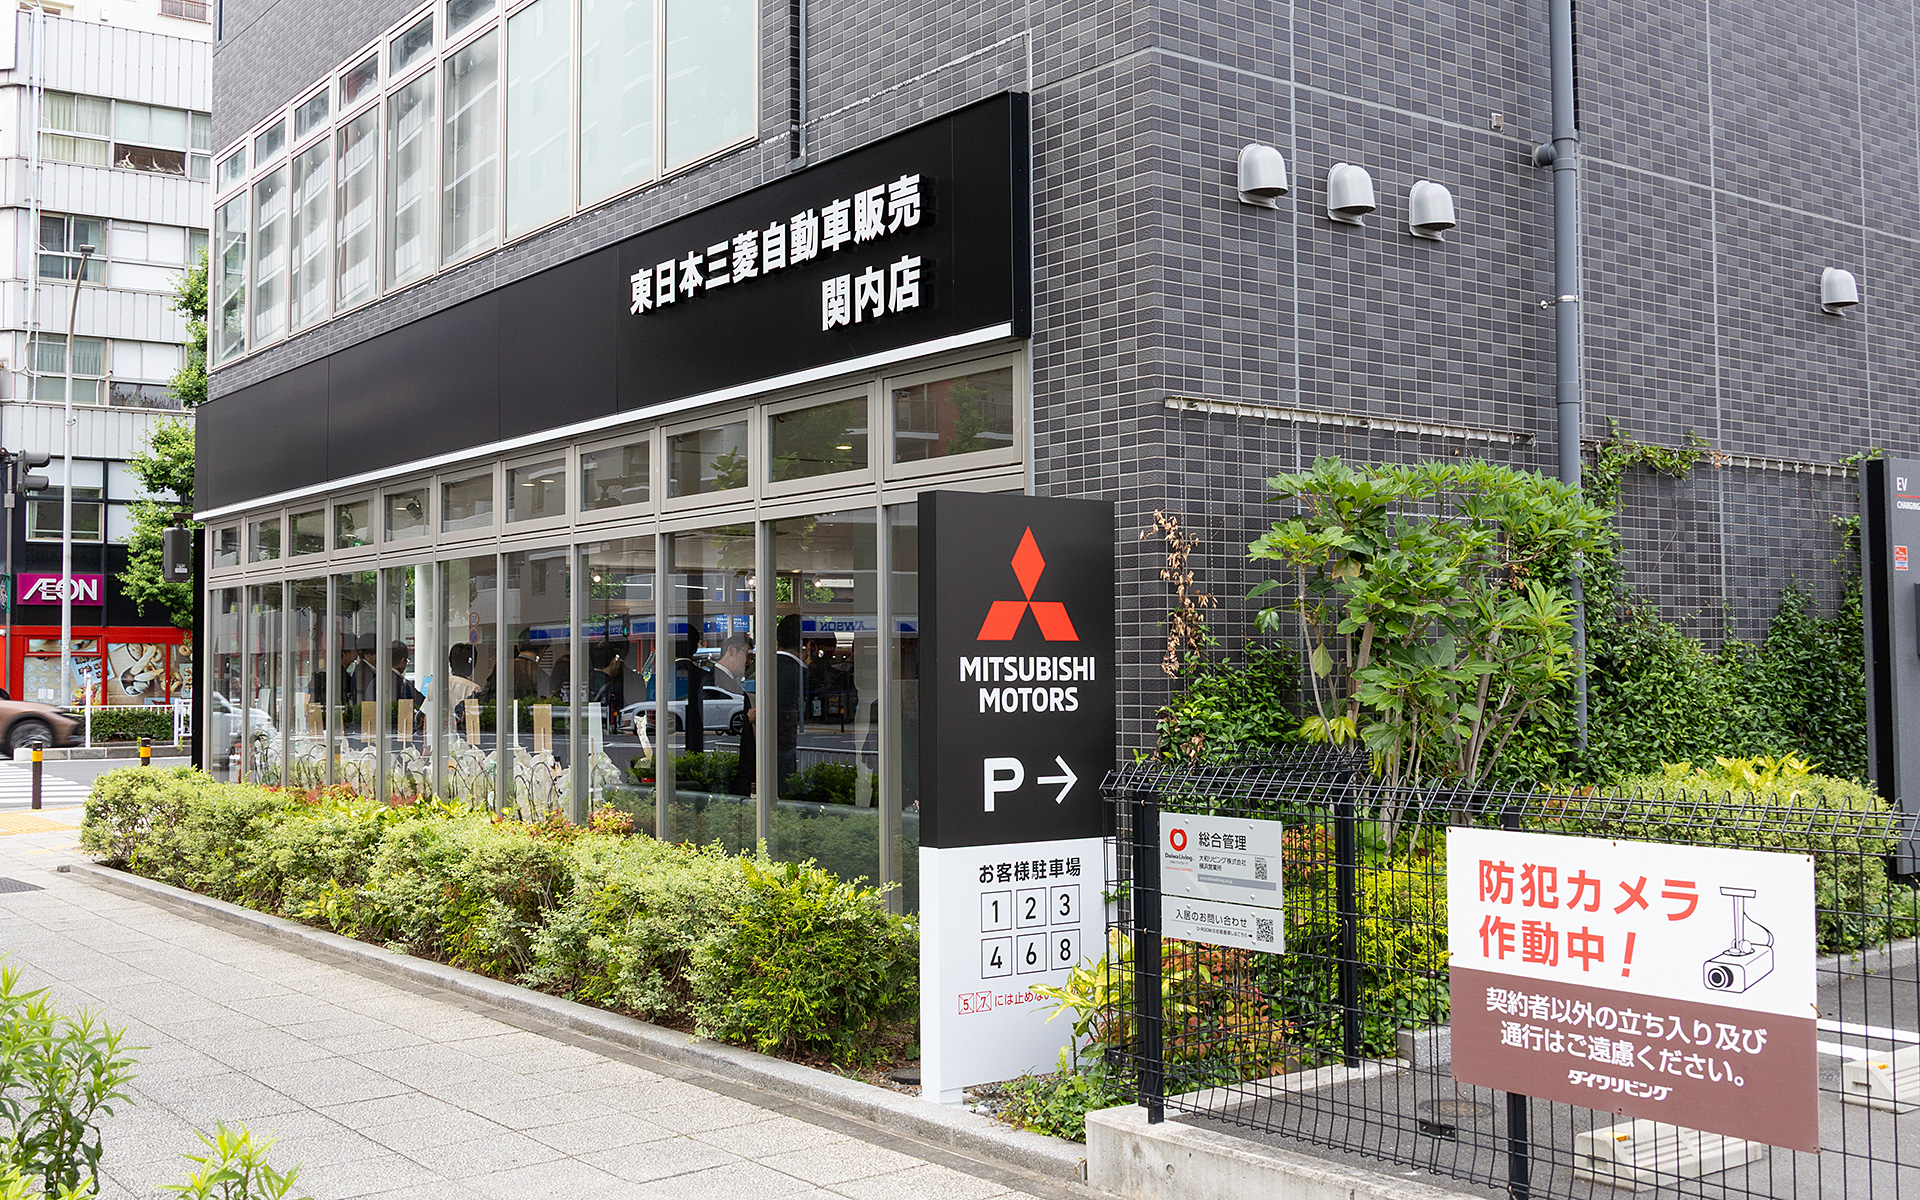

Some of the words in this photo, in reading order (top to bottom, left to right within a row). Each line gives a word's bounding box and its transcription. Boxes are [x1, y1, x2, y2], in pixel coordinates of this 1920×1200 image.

[630, 173, 921, 315] 東日本三菱自動車販売
[821, 255, 921, 331] 関内店
[1896, 477, 1908, 491] EV
[959, 656, 1096, 682] MITSUBISHI
[979, 687, 1079, 713] MOTORS
[983, 757, 1025, 812] P
[1198, 831, 1247, 851] 総合管理
[979, 856, 1081, 884] お客様駐車場
[1479, 859, 1699, 921] 防犯カメラ
[991, 900, 999, 923] 1
[1025, 897, 1036, 919] 2
[1059, 893, 1071, 916] 3
[1175, 909, 1248, 928] 入居のお問い合わせ
[990, 946, 1003, 969] 4
[1025, 942, 1037, 965] 6
[1059, 938, 1071, 961] 8
[1486, 987, 1768, 1055] 契約者以外の立ち入り及び
[1500, 1021, 1745, 1088] 通行はご遠慮ください。
[1567, 1069, 1673, 1102] ダイワリビング
